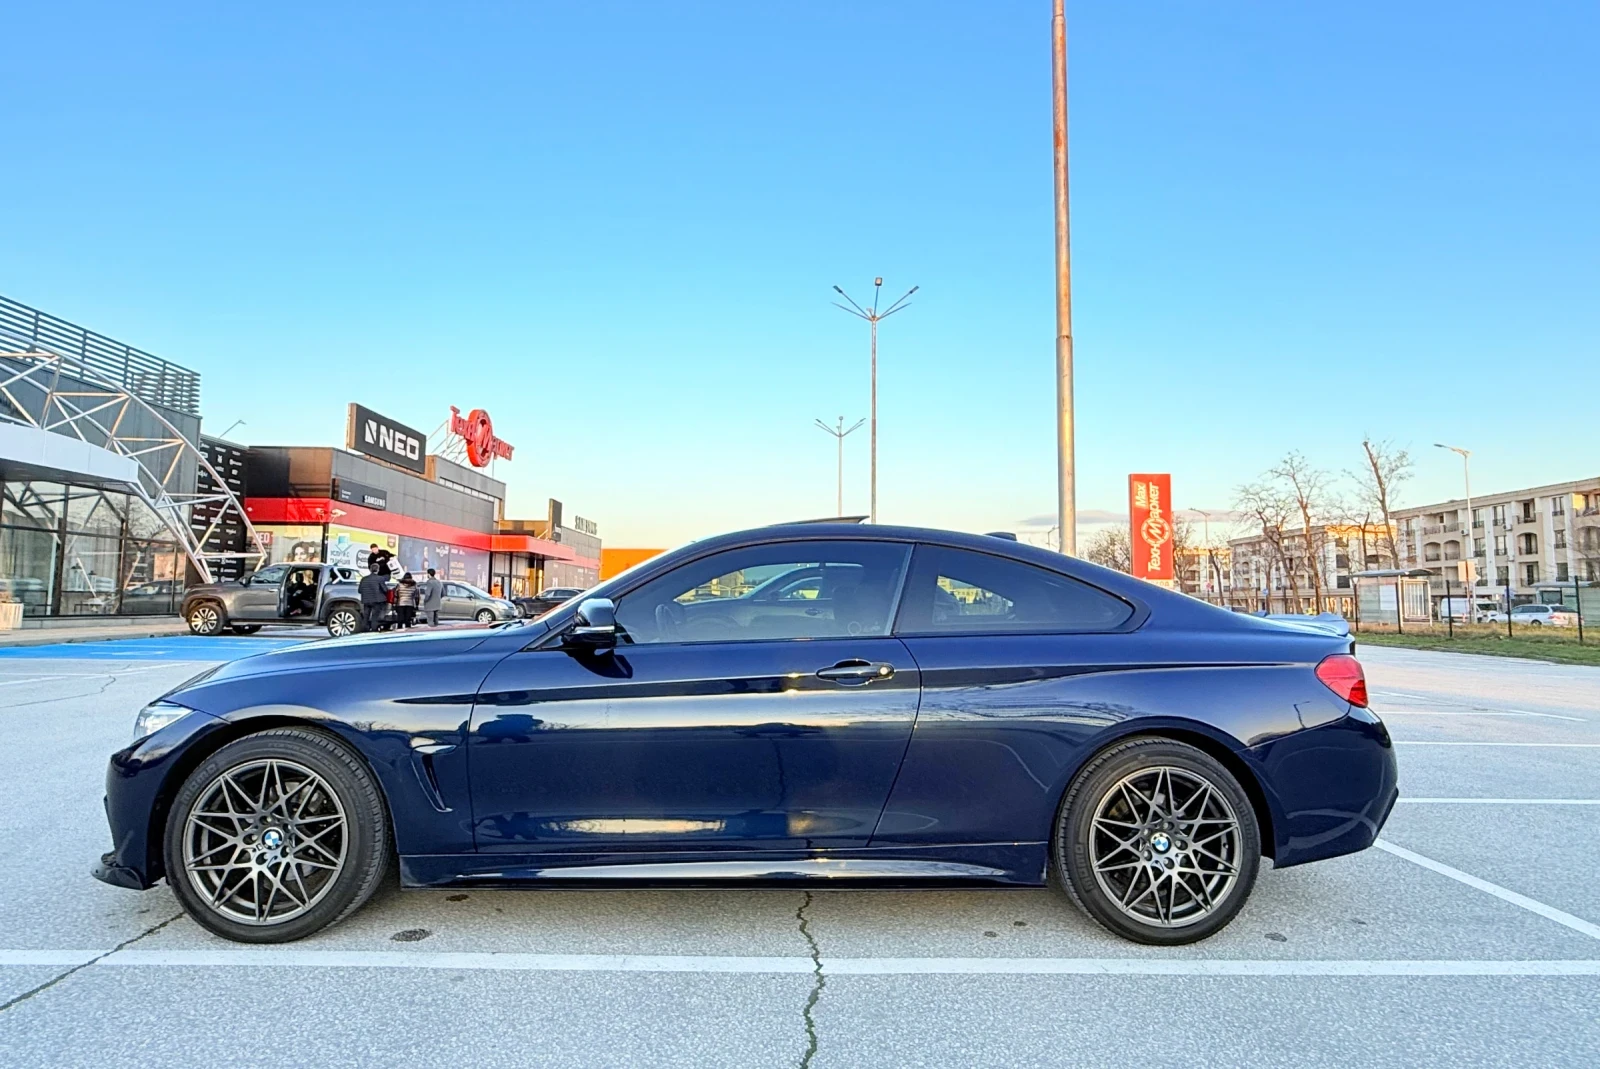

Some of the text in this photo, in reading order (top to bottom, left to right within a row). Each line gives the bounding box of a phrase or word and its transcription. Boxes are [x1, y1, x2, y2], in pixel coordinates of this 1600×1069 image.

[379, 424, 419, 461] NEO
[364, 494, 386, 507] SAMSUNG
[1134, 483, 1147, 507] Max
